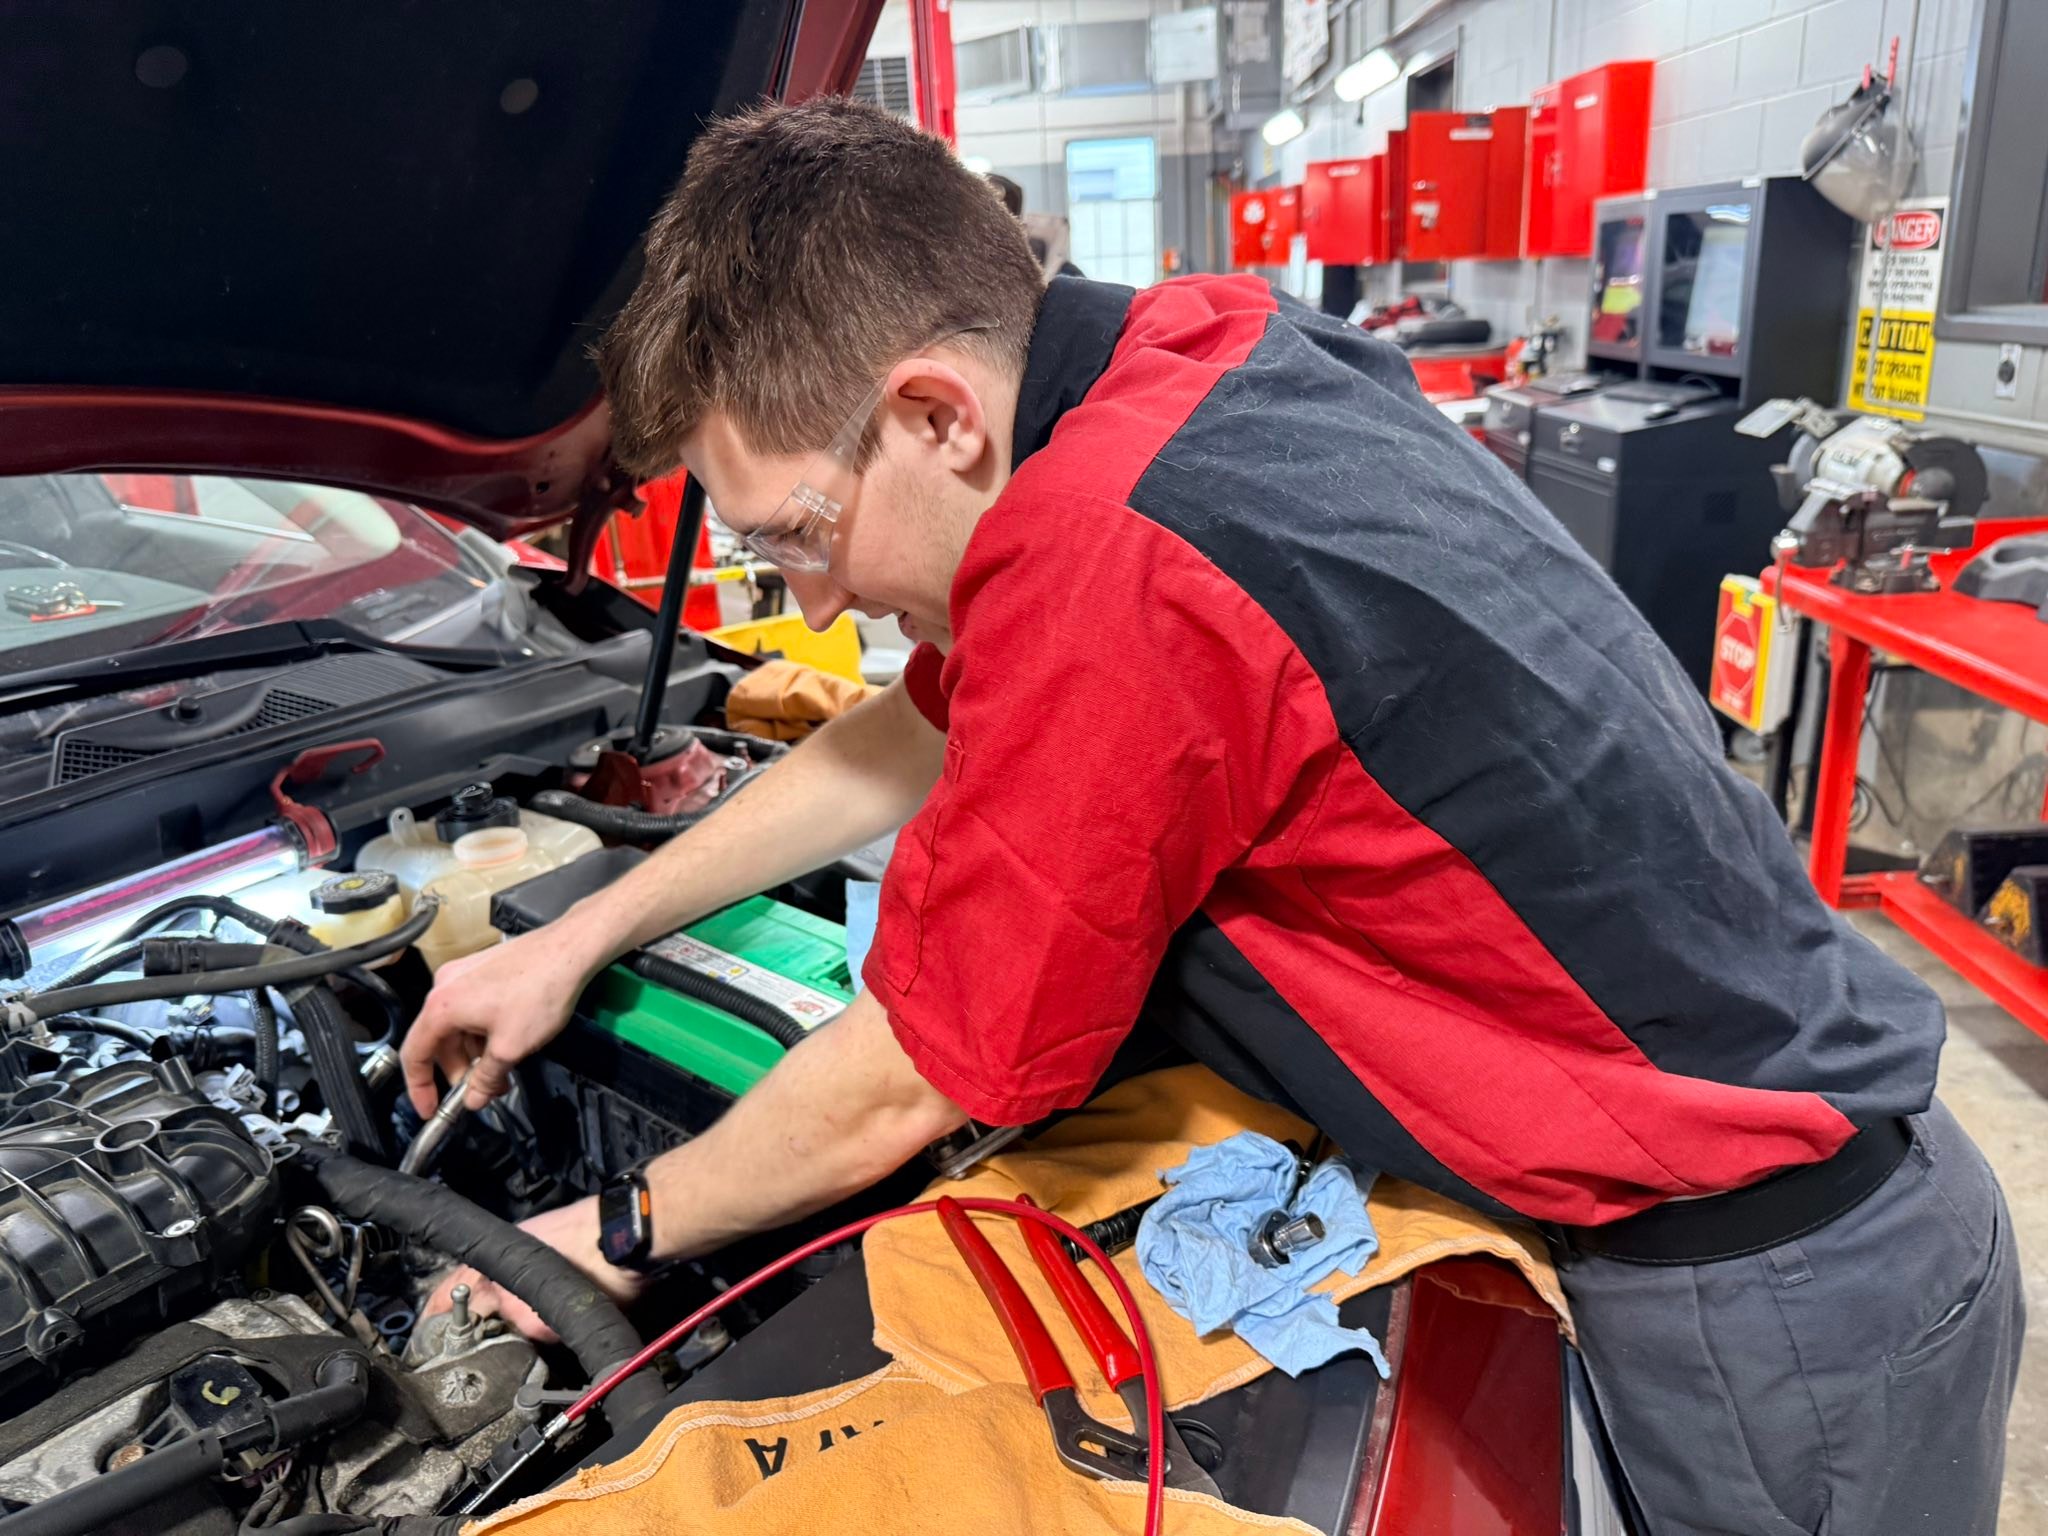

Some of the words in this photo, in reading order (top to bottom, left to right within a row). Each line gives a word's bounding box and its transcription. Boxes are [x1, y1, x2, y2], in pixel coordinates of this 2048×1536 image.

[1876, 218, 1937, 242] DNGER
[1860, 318, 1929, 352] CUTION
[1721, 634, 1755, 672] STOP
